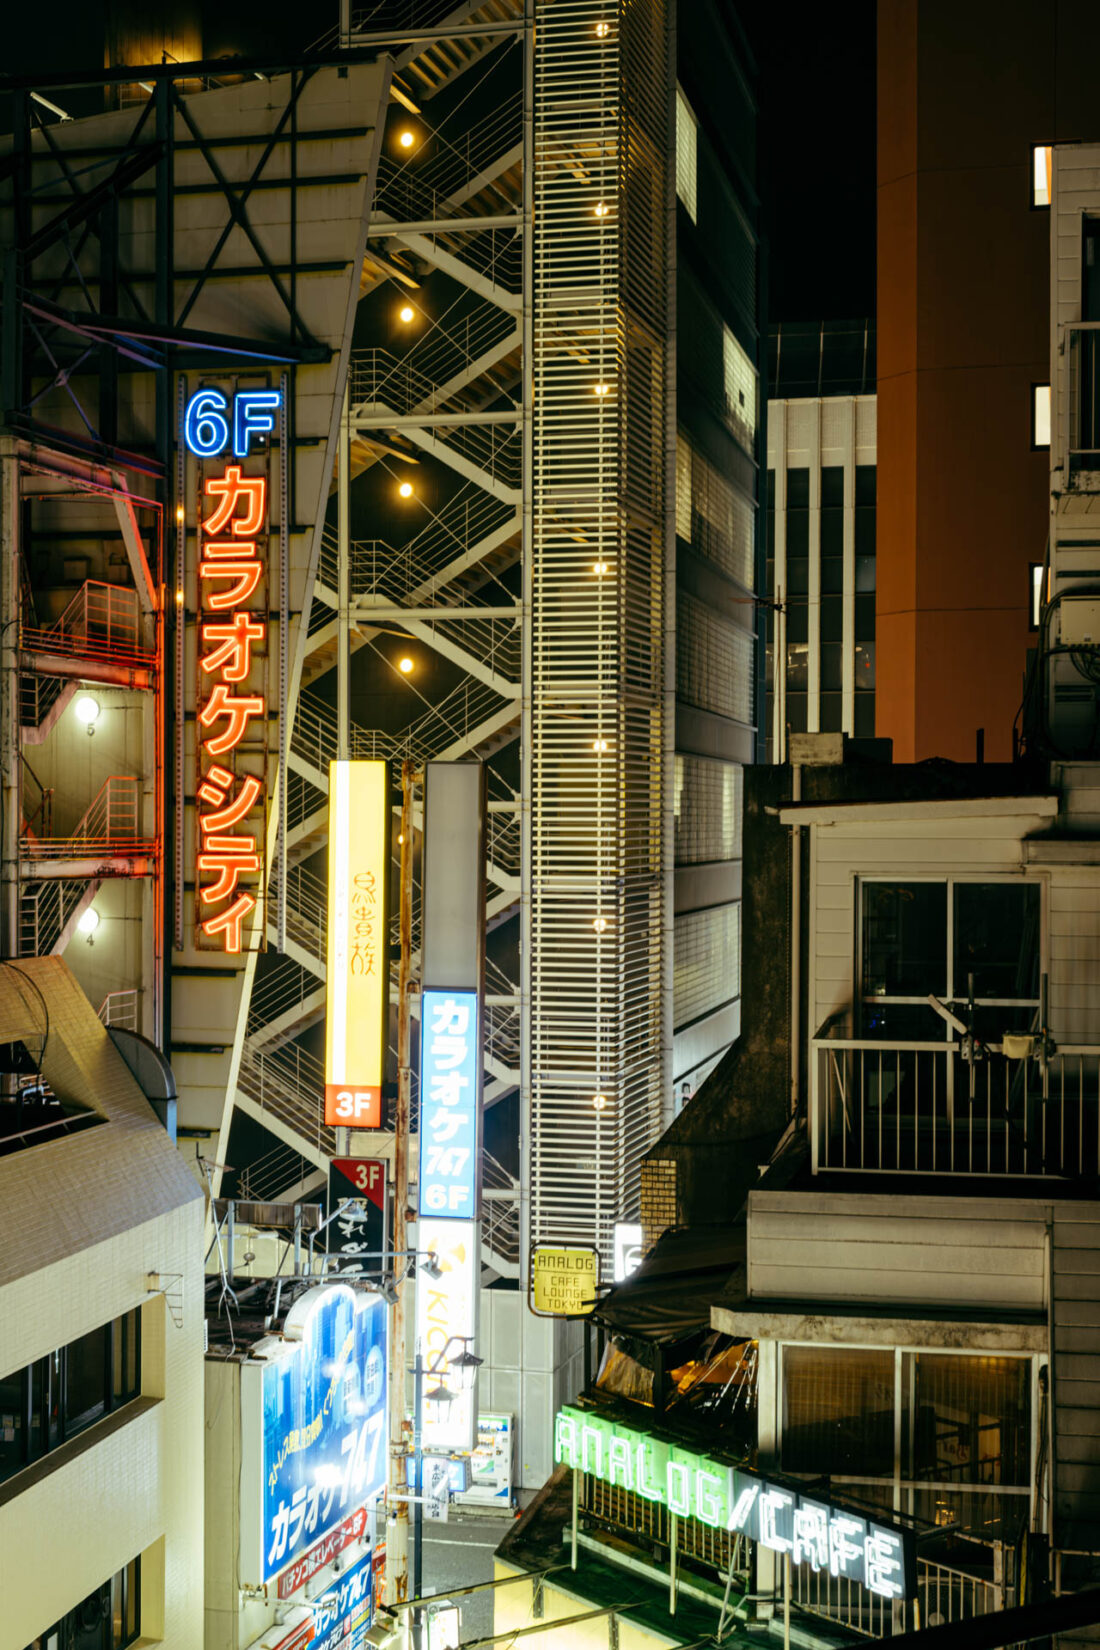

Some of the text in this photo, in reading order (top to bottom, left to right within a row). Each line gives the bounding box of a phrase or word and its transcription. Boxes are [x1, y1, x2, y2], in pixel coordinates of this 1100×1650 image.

[184, 389, 283, 458] 6F
[197, 464, 267, 954] カラオケシティ
[87, 722, 96, 737] 5
[86, 933, 95, 946] 4
[335, 1091, 371, 1118] 3F
[355, 1164, 379, 1190] 3F
[425, 1183, 470, 1210] 6F
[538, 1255, 593, 1270] ANALOG
[551, 1276, 580, 1288] CAFE
[543, 1286, 587, 1299] LOUNGE
[548, 1298, 584, 1311] TOKYO
